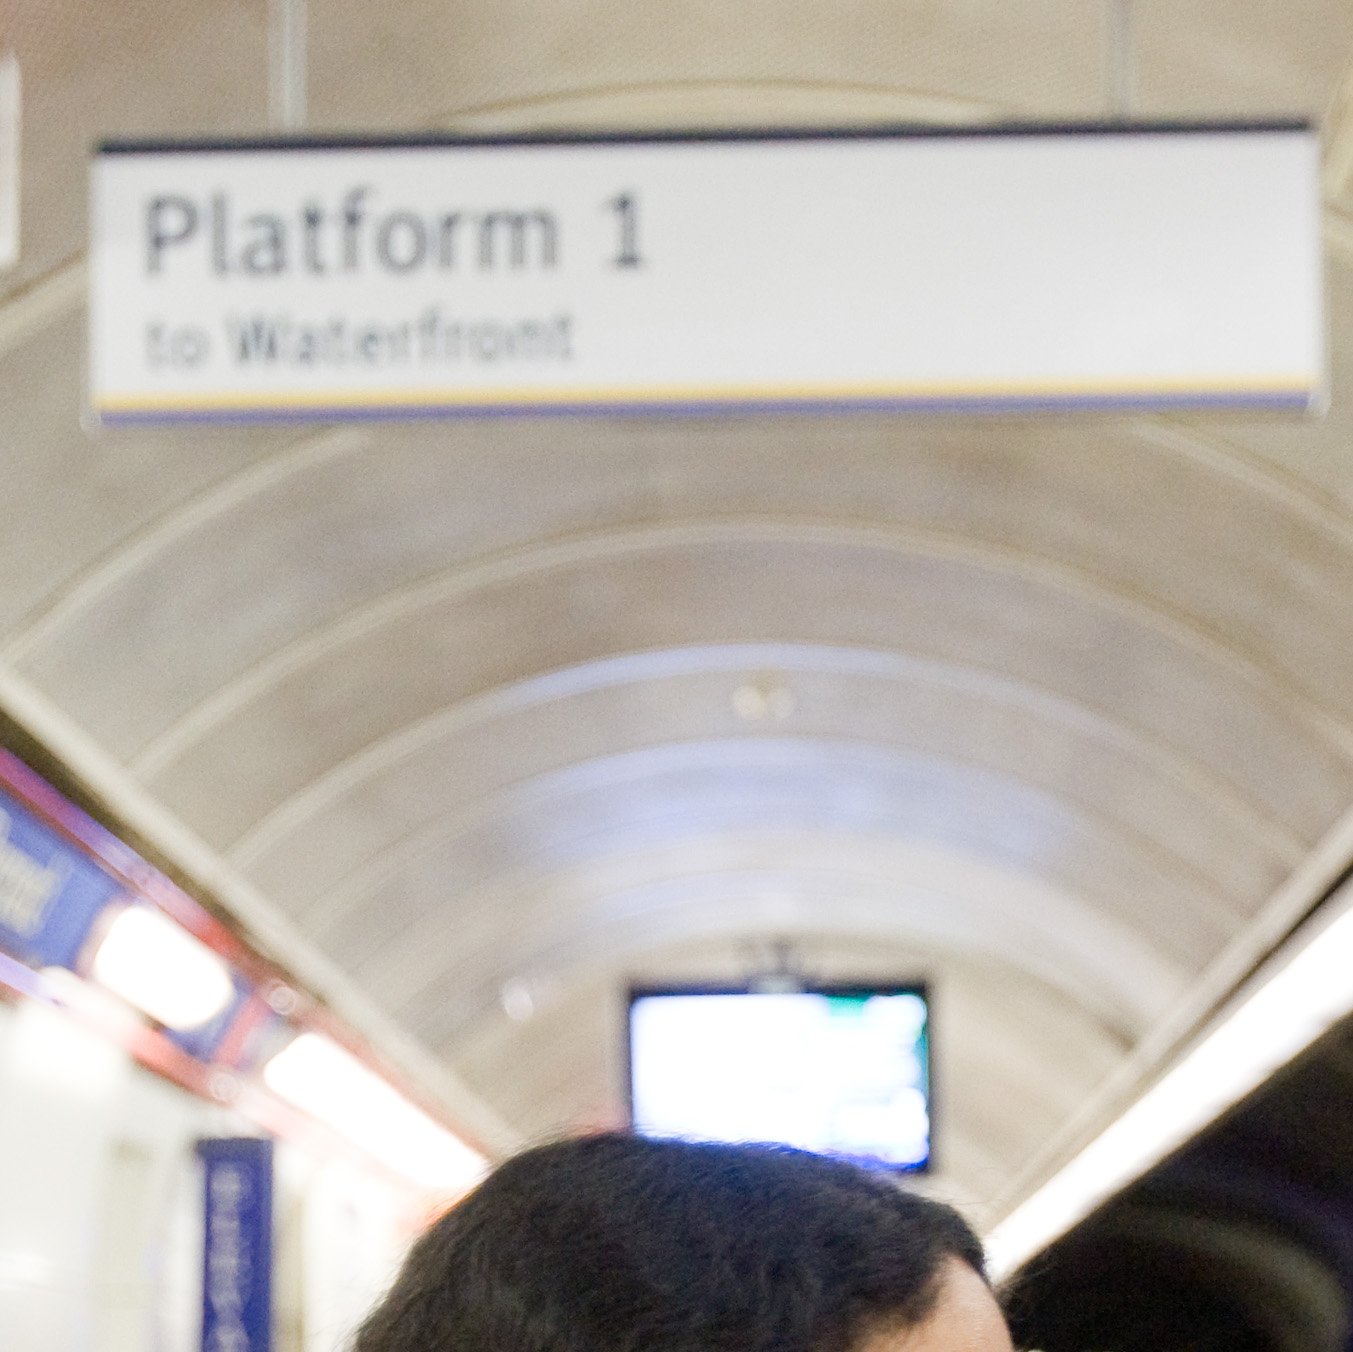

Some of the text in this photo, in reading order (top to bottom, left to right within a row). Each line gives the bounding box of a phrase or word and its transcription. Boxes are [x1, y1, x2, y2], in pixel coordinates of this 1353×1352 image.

[145, 185, 646, 277] Platform 1
[147, 305, 577, 369] to Waterfront
